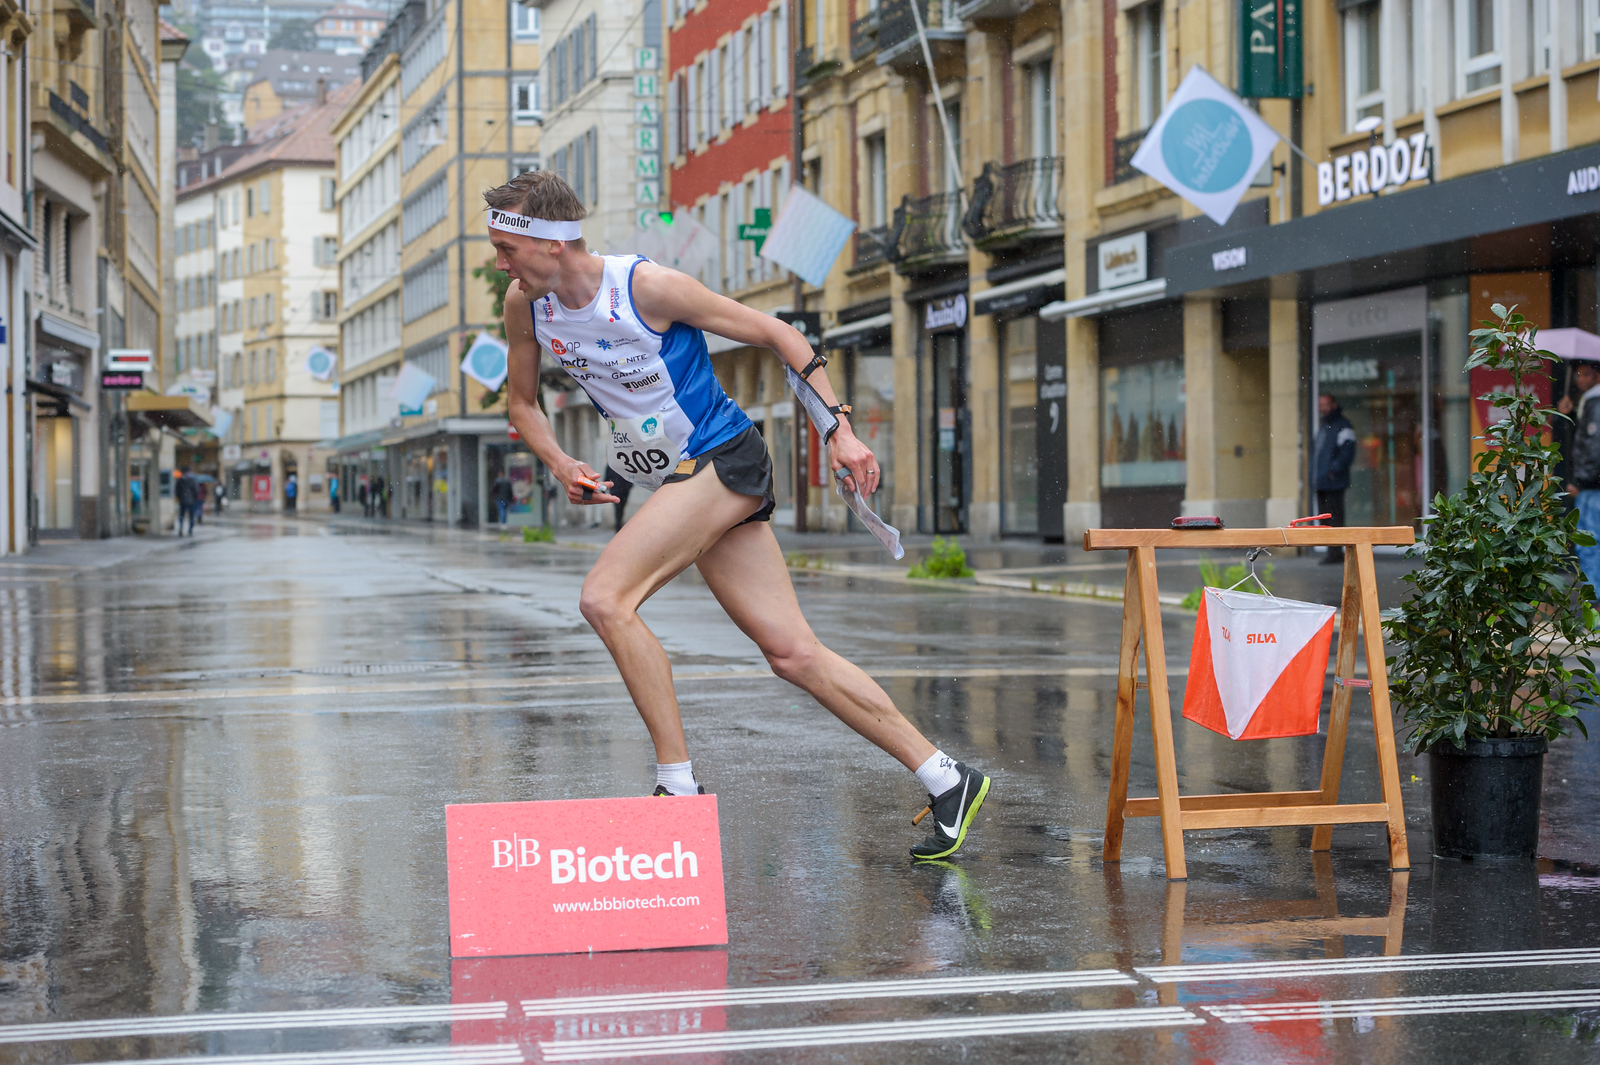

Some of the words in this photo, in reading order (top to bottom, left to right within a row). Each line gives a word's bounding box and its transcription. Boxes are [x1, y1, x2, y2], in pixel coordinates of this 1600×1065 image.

[1317, 131, 1429, 207] BERDOZ
[498, 212, 531, 229] Doofor
[630, 372, 661, 389] Doofor
[613, 432, 631, 444] EGK
[616, 448, 670, 475] 309
[1246, 632, 1278, 645] SILVA
[550, 841, 699, 885] Biotech
[552, 894, 700, 913] www.bbbiotech.com
